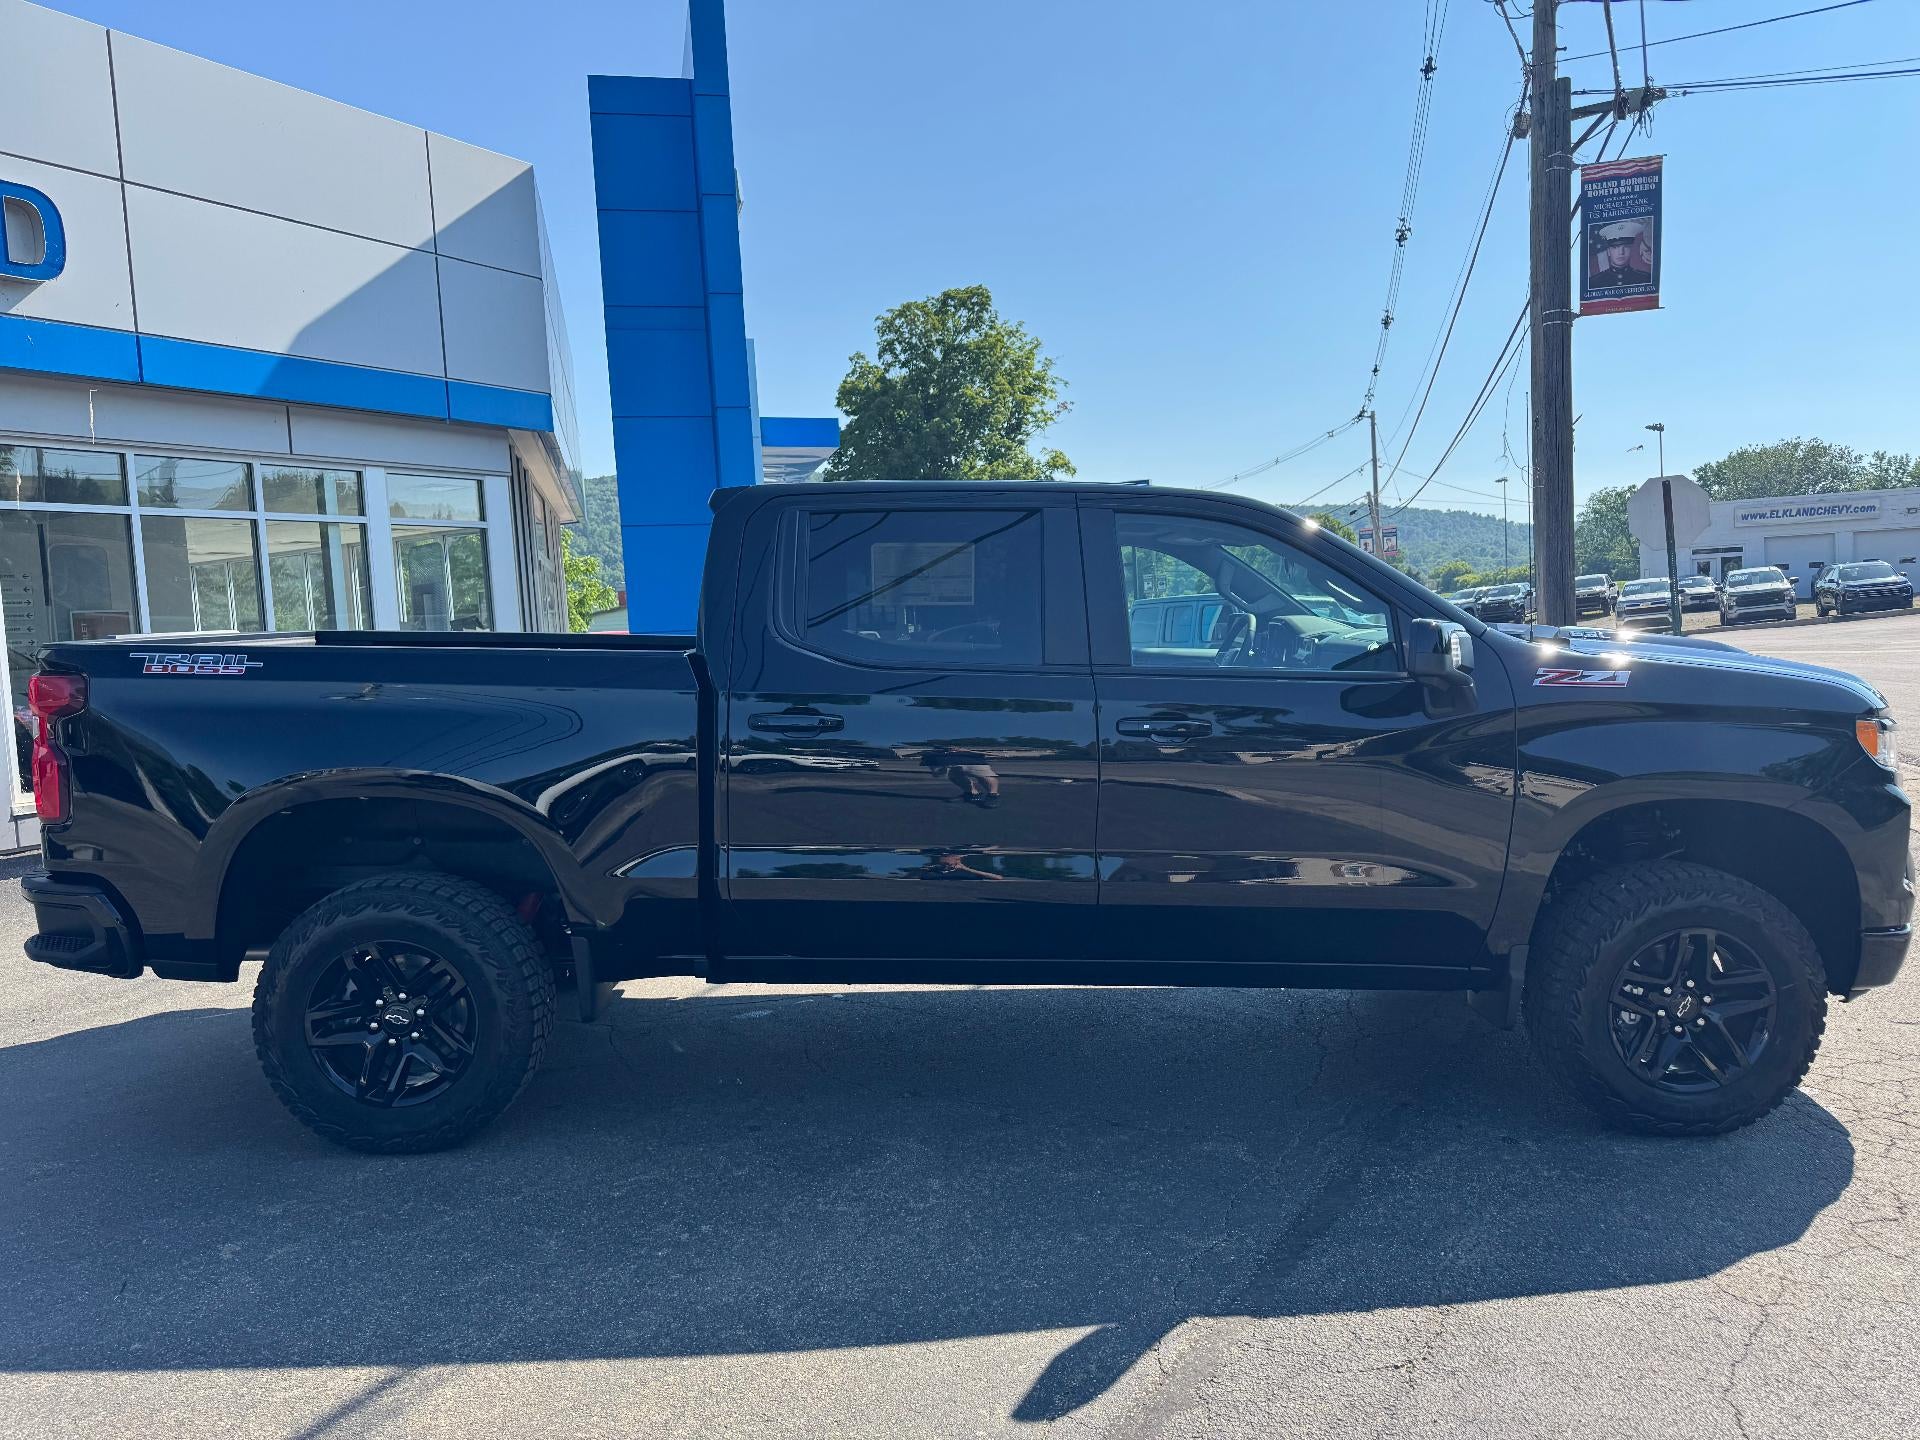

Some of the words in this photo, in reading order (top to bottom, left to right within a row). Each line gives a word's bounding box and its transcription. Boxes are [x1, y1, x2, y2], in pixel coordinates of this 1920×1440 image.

[1584, 180, 1618, 191] ELKLAND
[1620, 175, 1660, 187] BOROUGH
[1587, 185, 1632, 198] HOMETOWN
[1634, 183, 1656, 192] HERO
[1593, 201, 1623, 210] MICHAEL
[1626, 198, 1649, 207] PLANK
[1602, 208, 1630, 218] MARINE
[1741, 504, 1877, 521] www.ELKLANDCHEVY.com
[129, 652, 264, 667] TRAIL
[143, 664, 247, 675] BOSS
[1532, 667, 1632, 688] Z71
